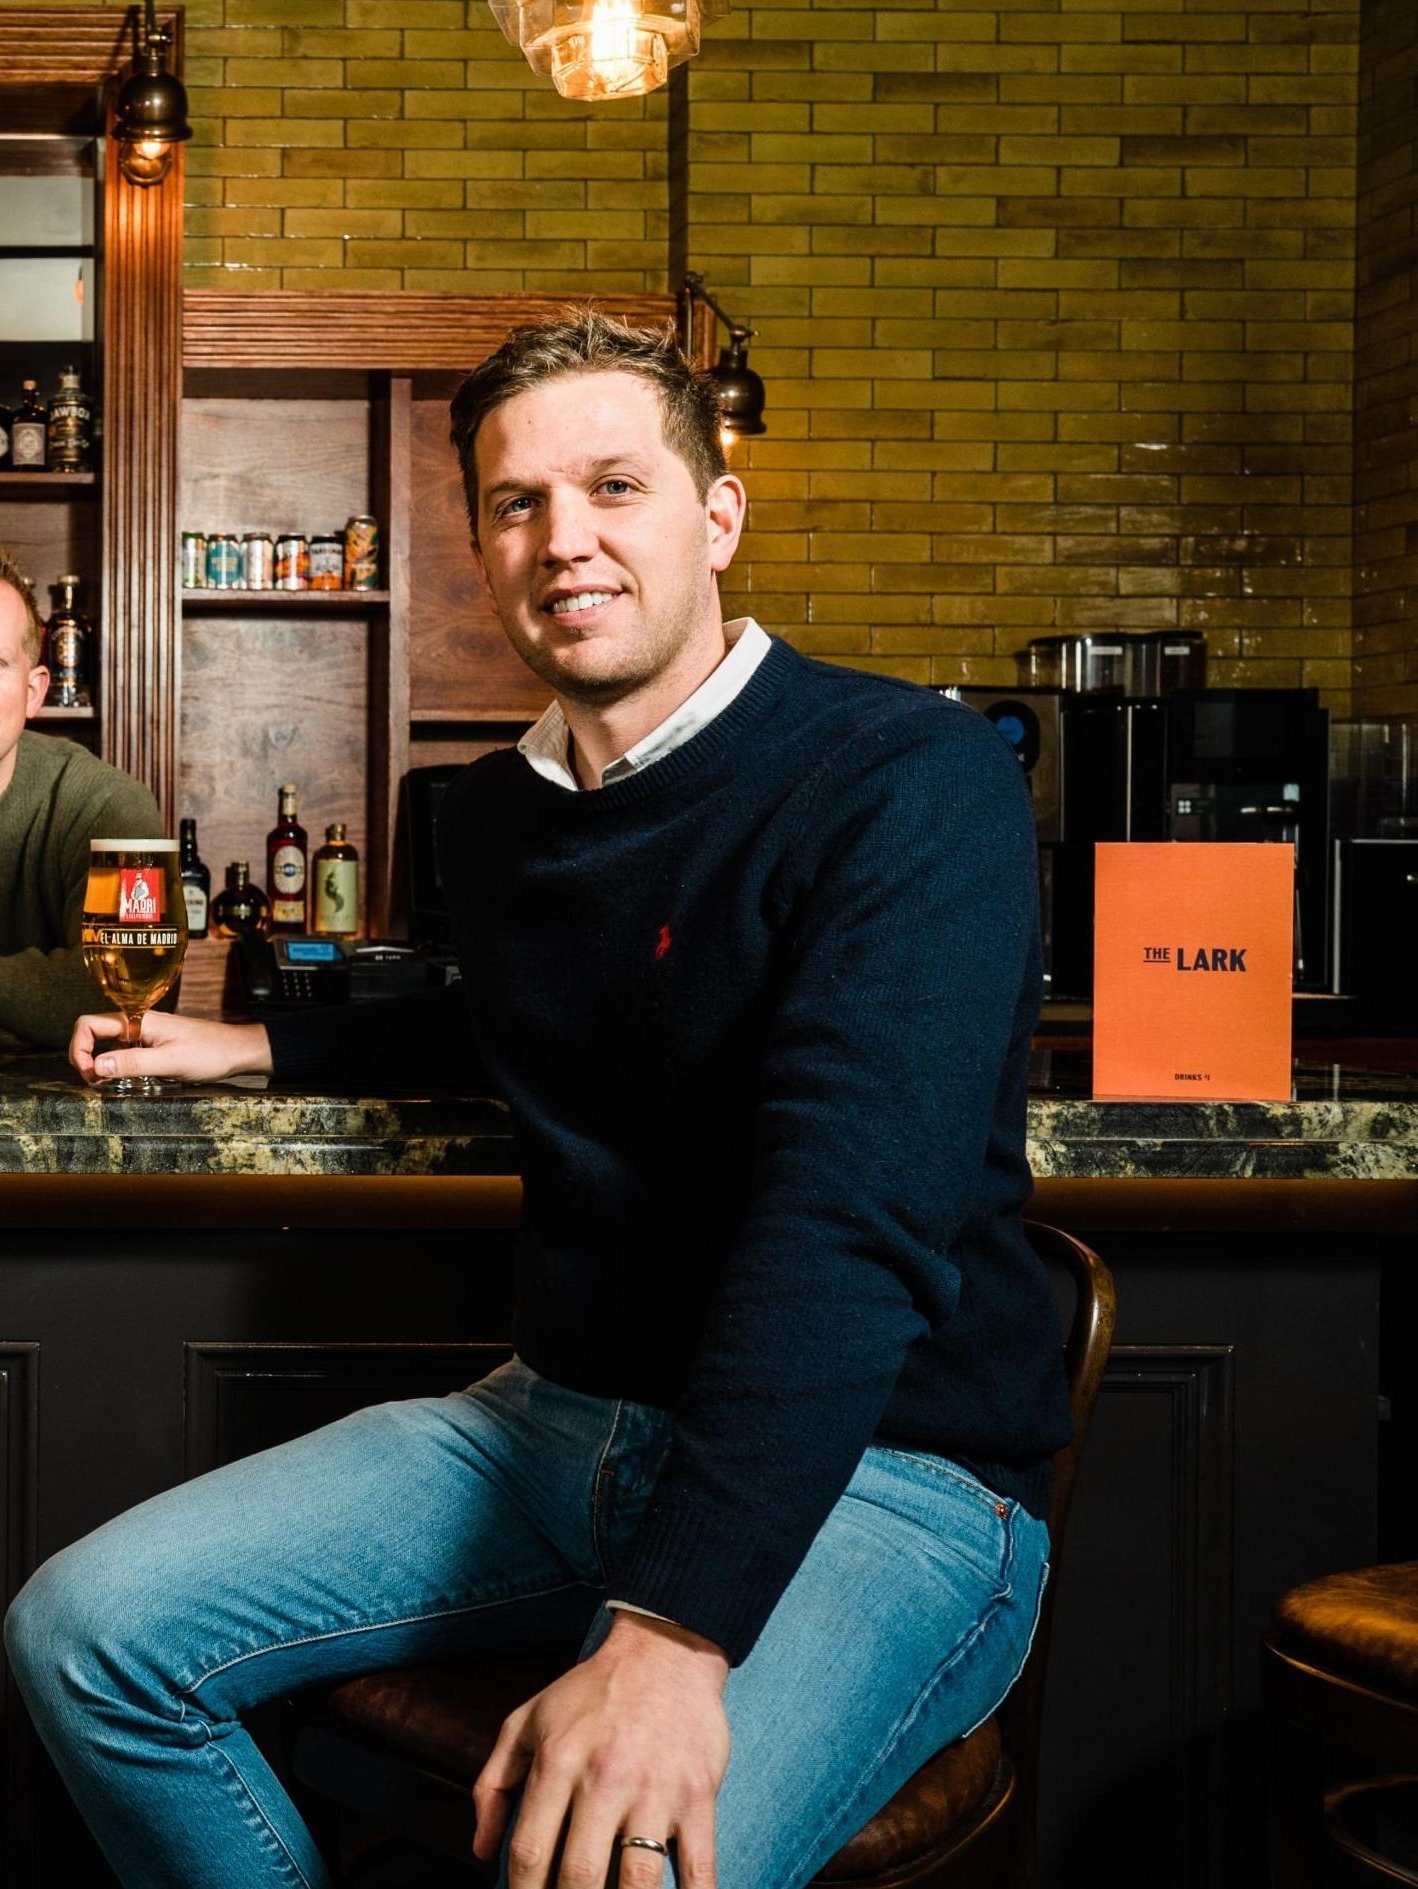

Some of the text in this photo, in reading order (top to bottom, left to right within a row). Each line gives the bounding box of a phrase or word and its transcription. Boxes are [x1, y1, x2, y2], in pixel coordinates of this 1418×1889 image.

[101, 933, 109, 944] EL
[112, 933, 134, 945] ALMA
[137, 933, 147, 945] DE
[150, 933, 177, 945] MADRID
[1143, 947, 1247, 972] THE LARK
[1174, 1073, 1202, 1081] DRINKS
